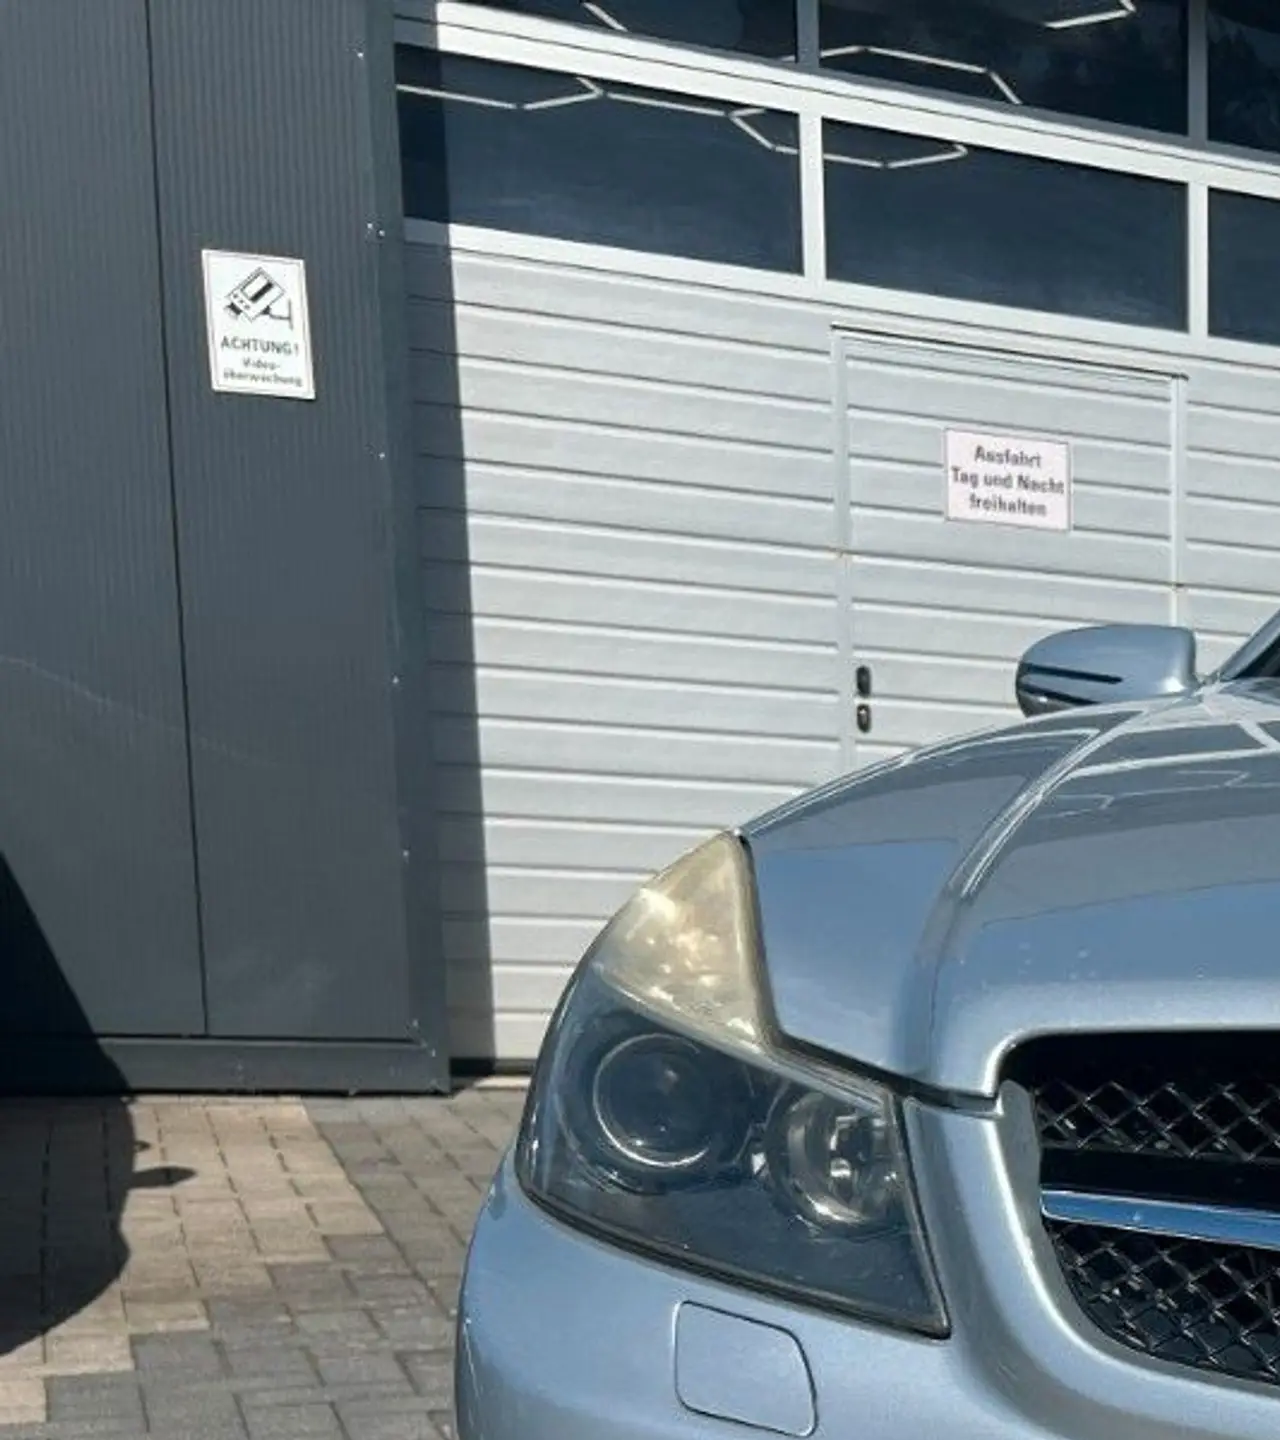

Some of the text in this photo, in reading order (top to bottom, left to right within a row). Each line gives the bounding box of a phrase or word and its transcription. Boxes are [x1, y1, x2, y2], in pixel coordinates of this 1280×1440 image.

[974, 444, 1042, 468] Ausfahrt
[951, 465, 1065, 495] Tag und Nacht
[969, 493, 1047, 516] freihalten
